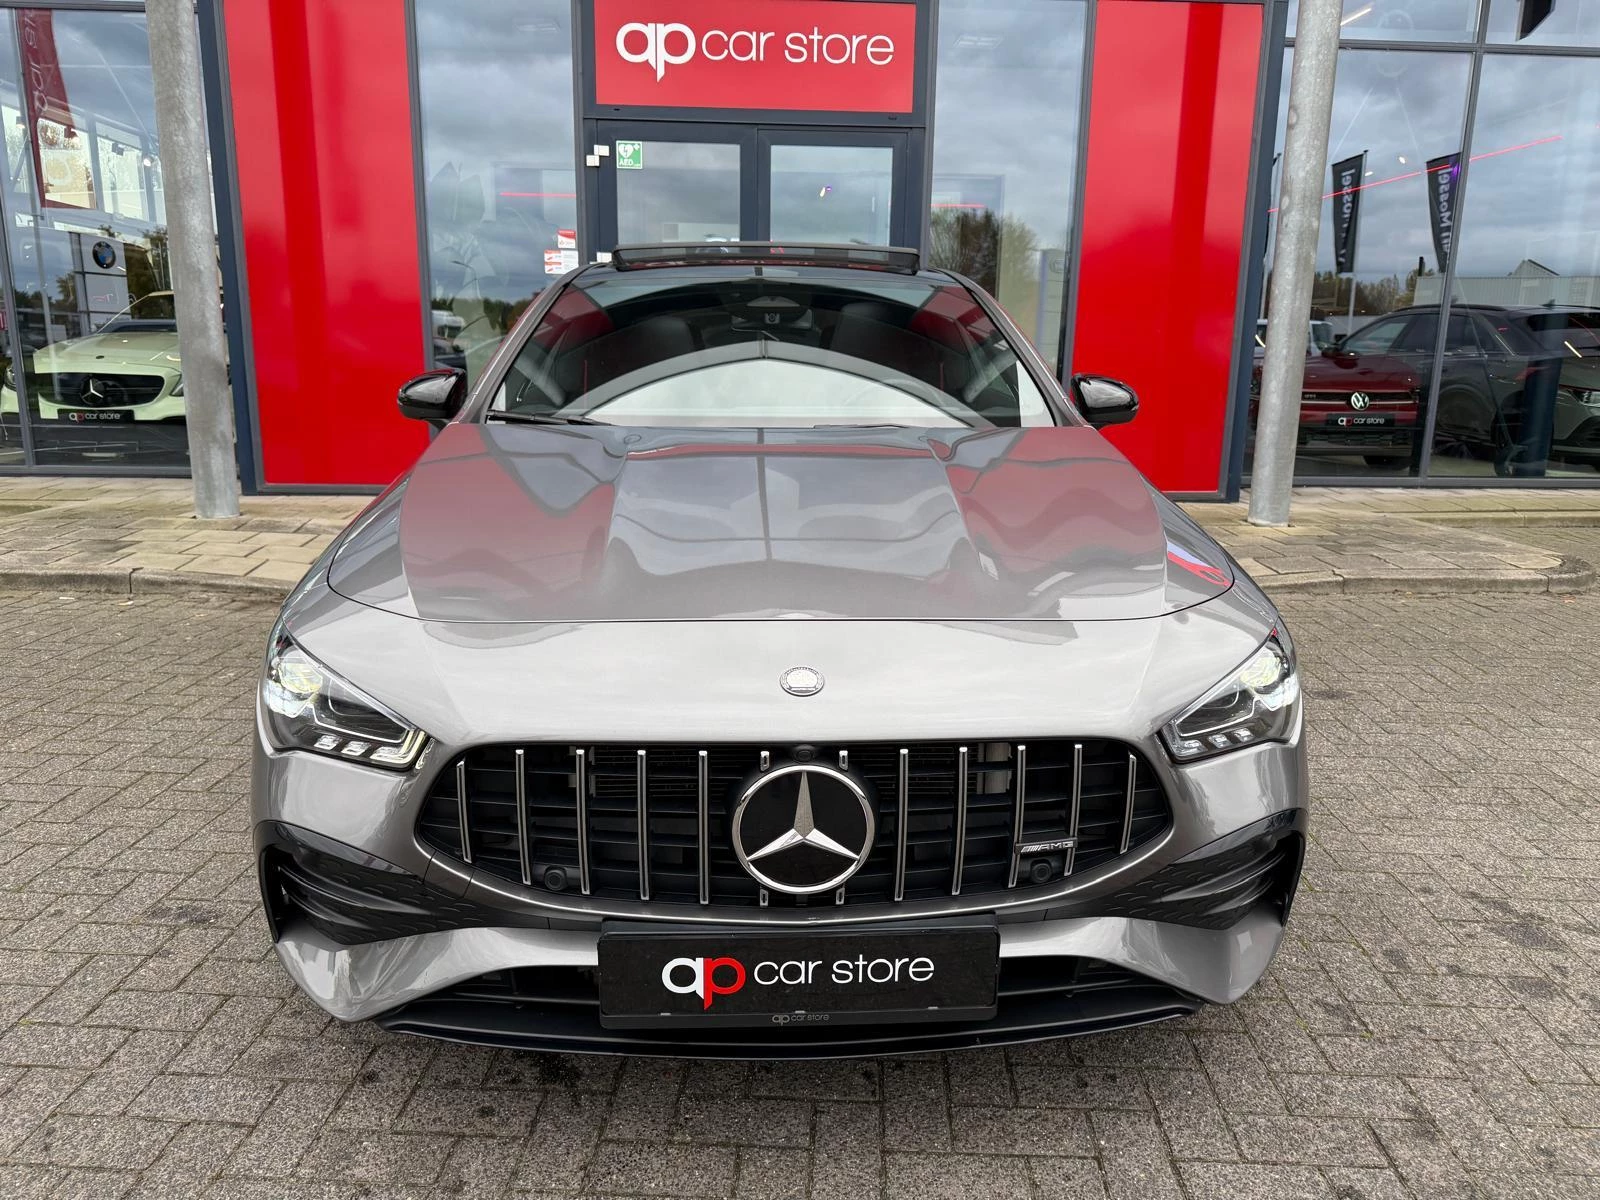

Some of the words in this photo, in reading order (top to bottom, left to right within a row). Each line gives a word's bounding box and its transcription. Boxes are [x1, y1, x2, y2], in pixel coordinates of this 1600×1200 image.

[615, 22, 697, 83] ap
[701, 29, 775, 61] car
[784, 26, 895, 66] store
[619, 158, 633, 166] AED
[99, 412, 120, 420] store
[661, 957, 746, 1010] ap
[753, 960, 822, 985] car
[831, 954, 935, 984] store
[791, 1014, 806, 1022] car
